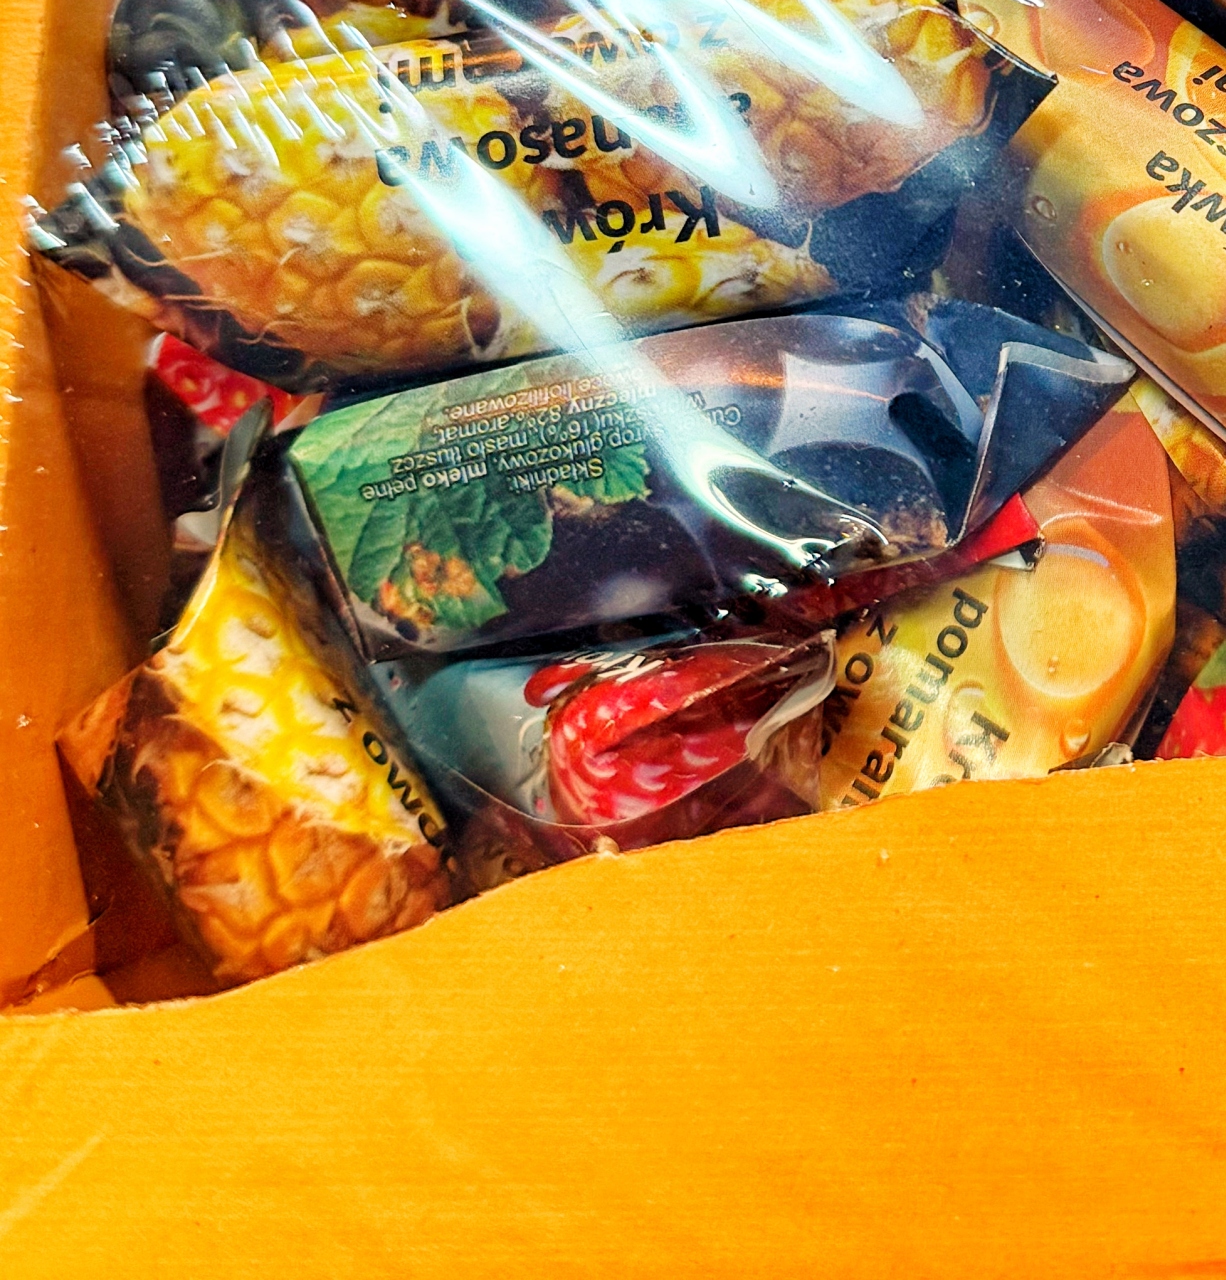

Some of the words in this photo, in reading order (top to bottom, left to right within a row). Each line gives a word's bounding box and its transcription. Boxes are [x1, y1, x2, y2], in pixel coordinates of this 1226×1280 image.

[443, 381, 577, 420] liofilizowane.
[567, 384, 658, 416] mleczny
[391, 446, 464, 474] tłuszcz
[465, 429, 532, 462] masło
[495, 434, 604, 473] glukozowy,
[361, 474, 420, 503] pełne
[423, 460, 489, 490] mleko
[504, 457, 605, 496] Składniki:
[865, 614, 899, 648] z
[332, 695, 358, 723] z
